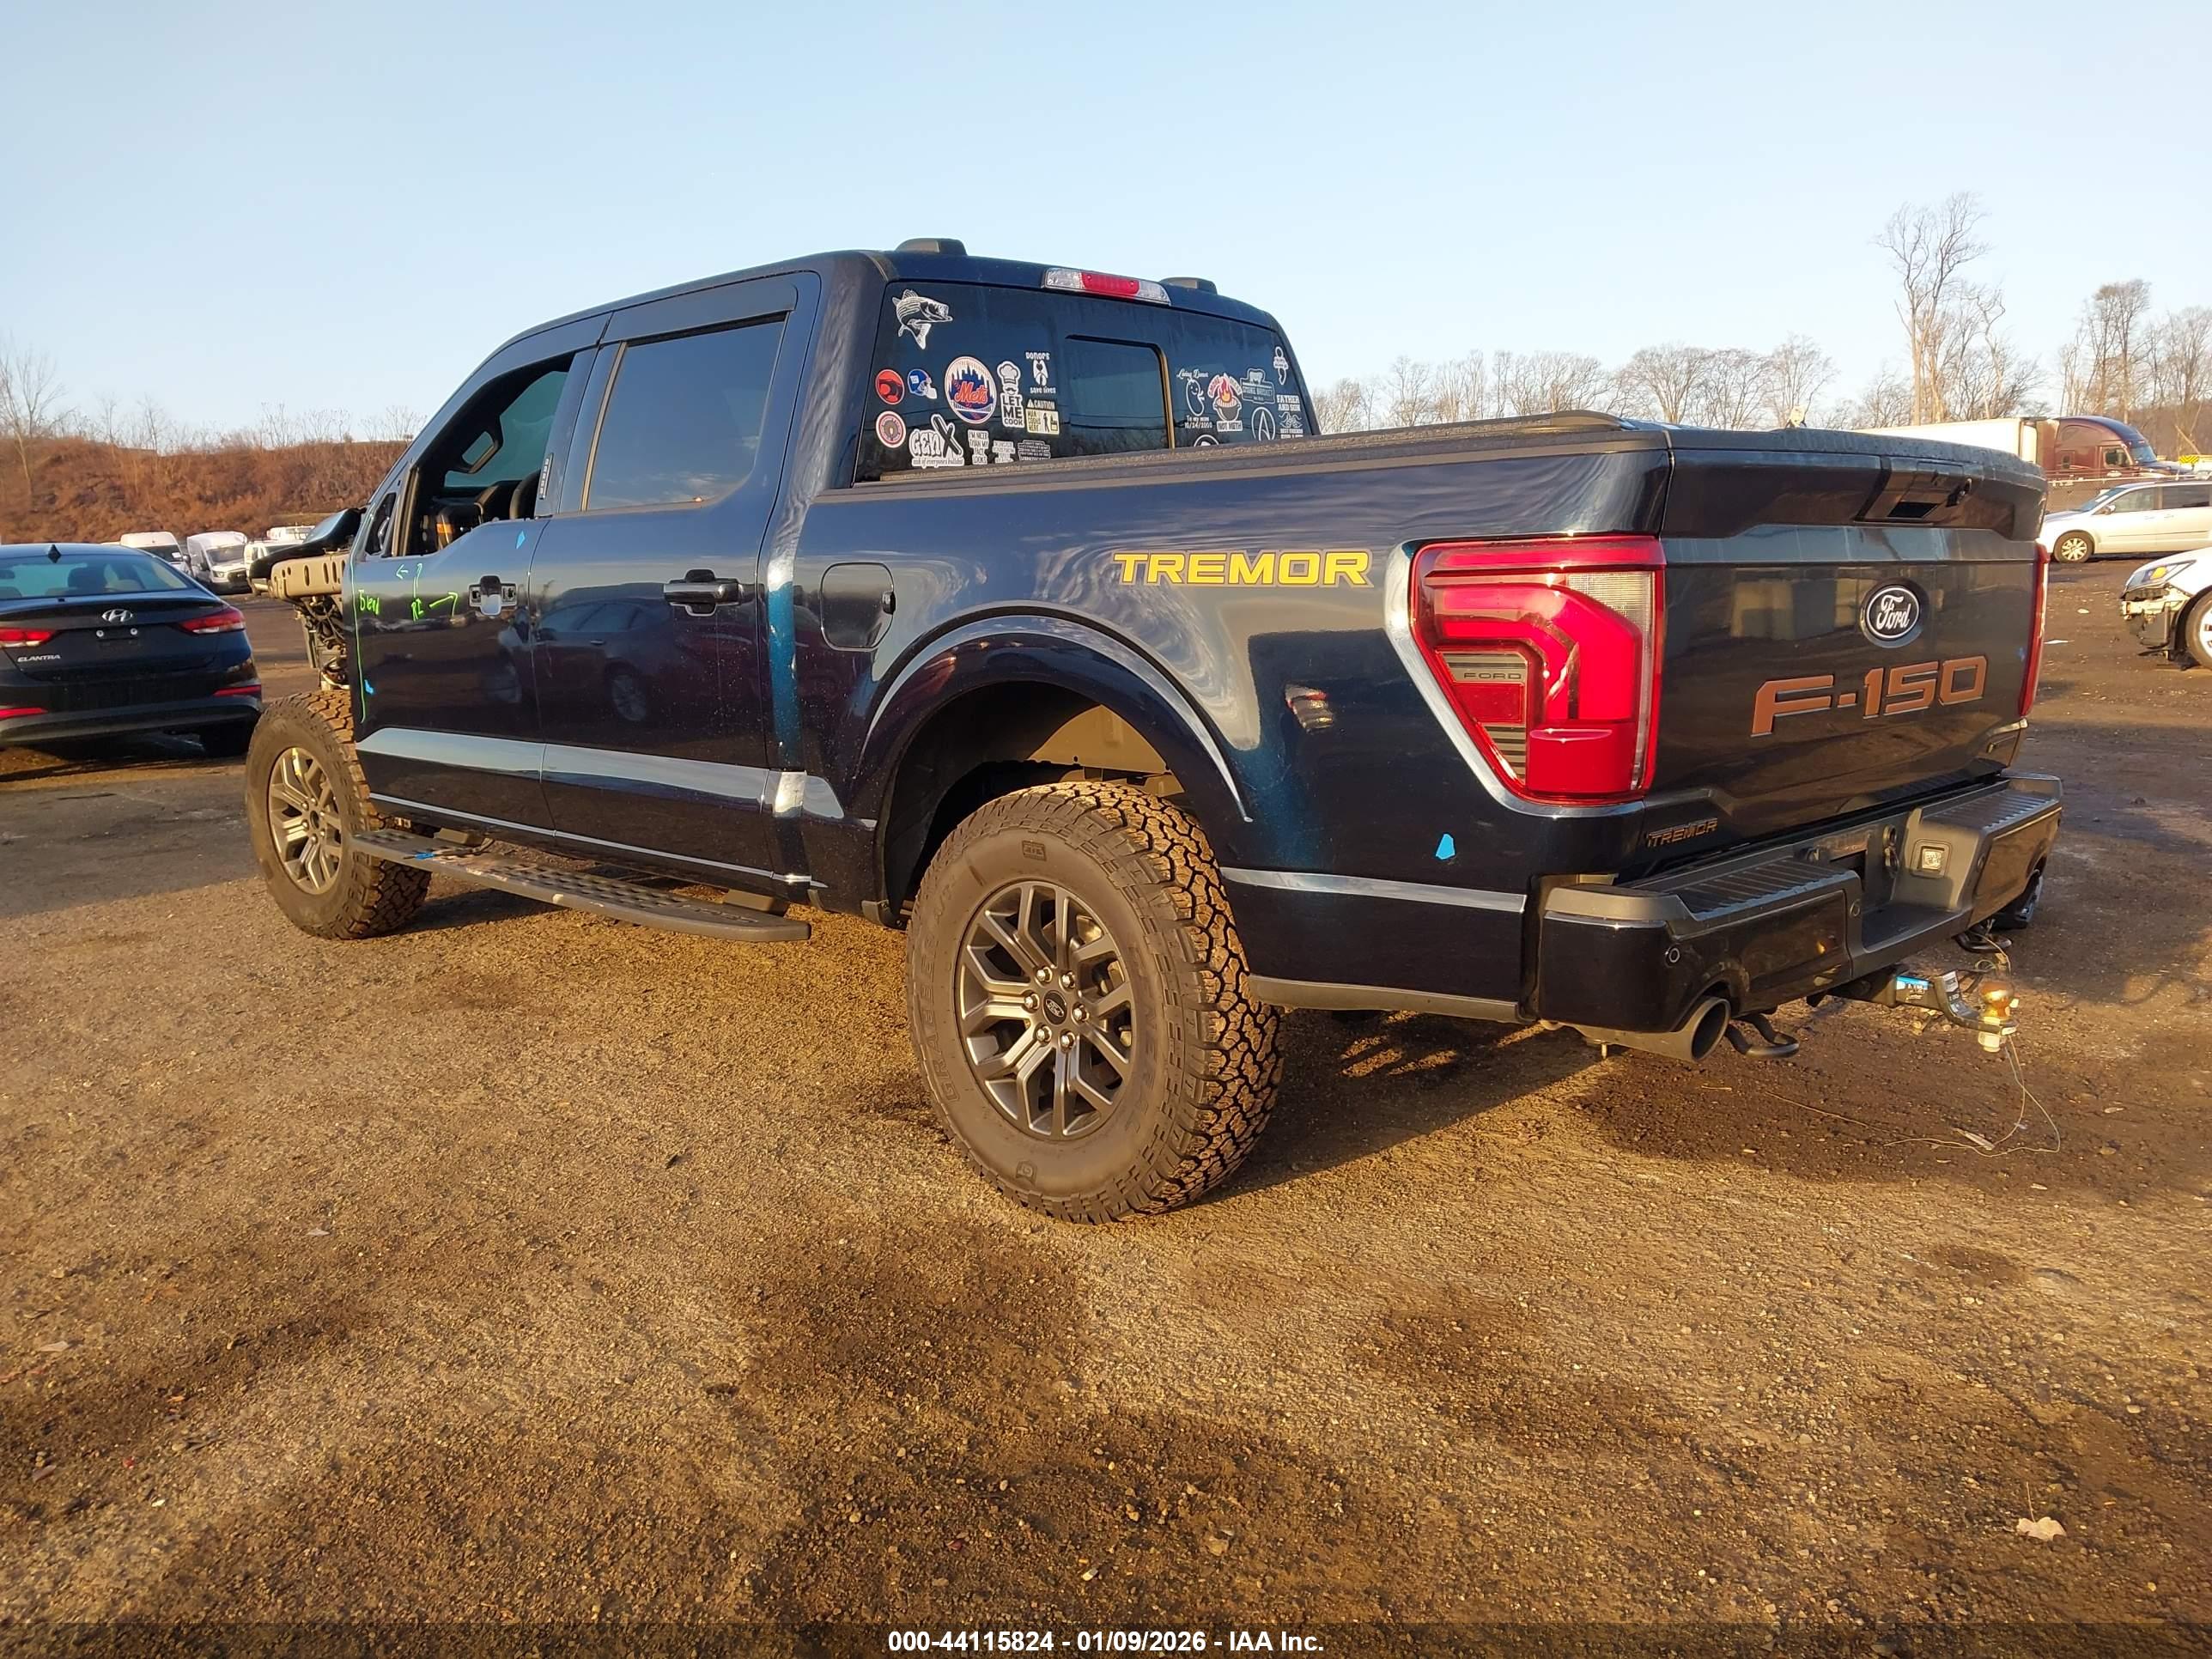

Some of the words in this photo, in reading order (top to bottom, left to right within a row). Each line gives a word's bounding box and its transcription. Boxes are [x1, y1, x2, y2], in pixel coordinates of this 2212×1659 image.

[954, 380, 988, 404] Mets
[1001, 396, 1021, 406] LET
[1034, 400, 1055, 410] CAUTION
[1276, 394, 1300, 404] FATHER
[1003, 406, 1022, 418] ME
[1218, 422, 1227, 430] NOT
[1228, 422, 1241, 430] METH
[1110, 550, 1372, 586] TREMOR
[1876, 594, 1911, 630] Ford
[17, 653, 61, 662] ELANTRA
[1750, 654, 1988, 738] F-150
[1647, 817, 1718, 848] TREMOR
